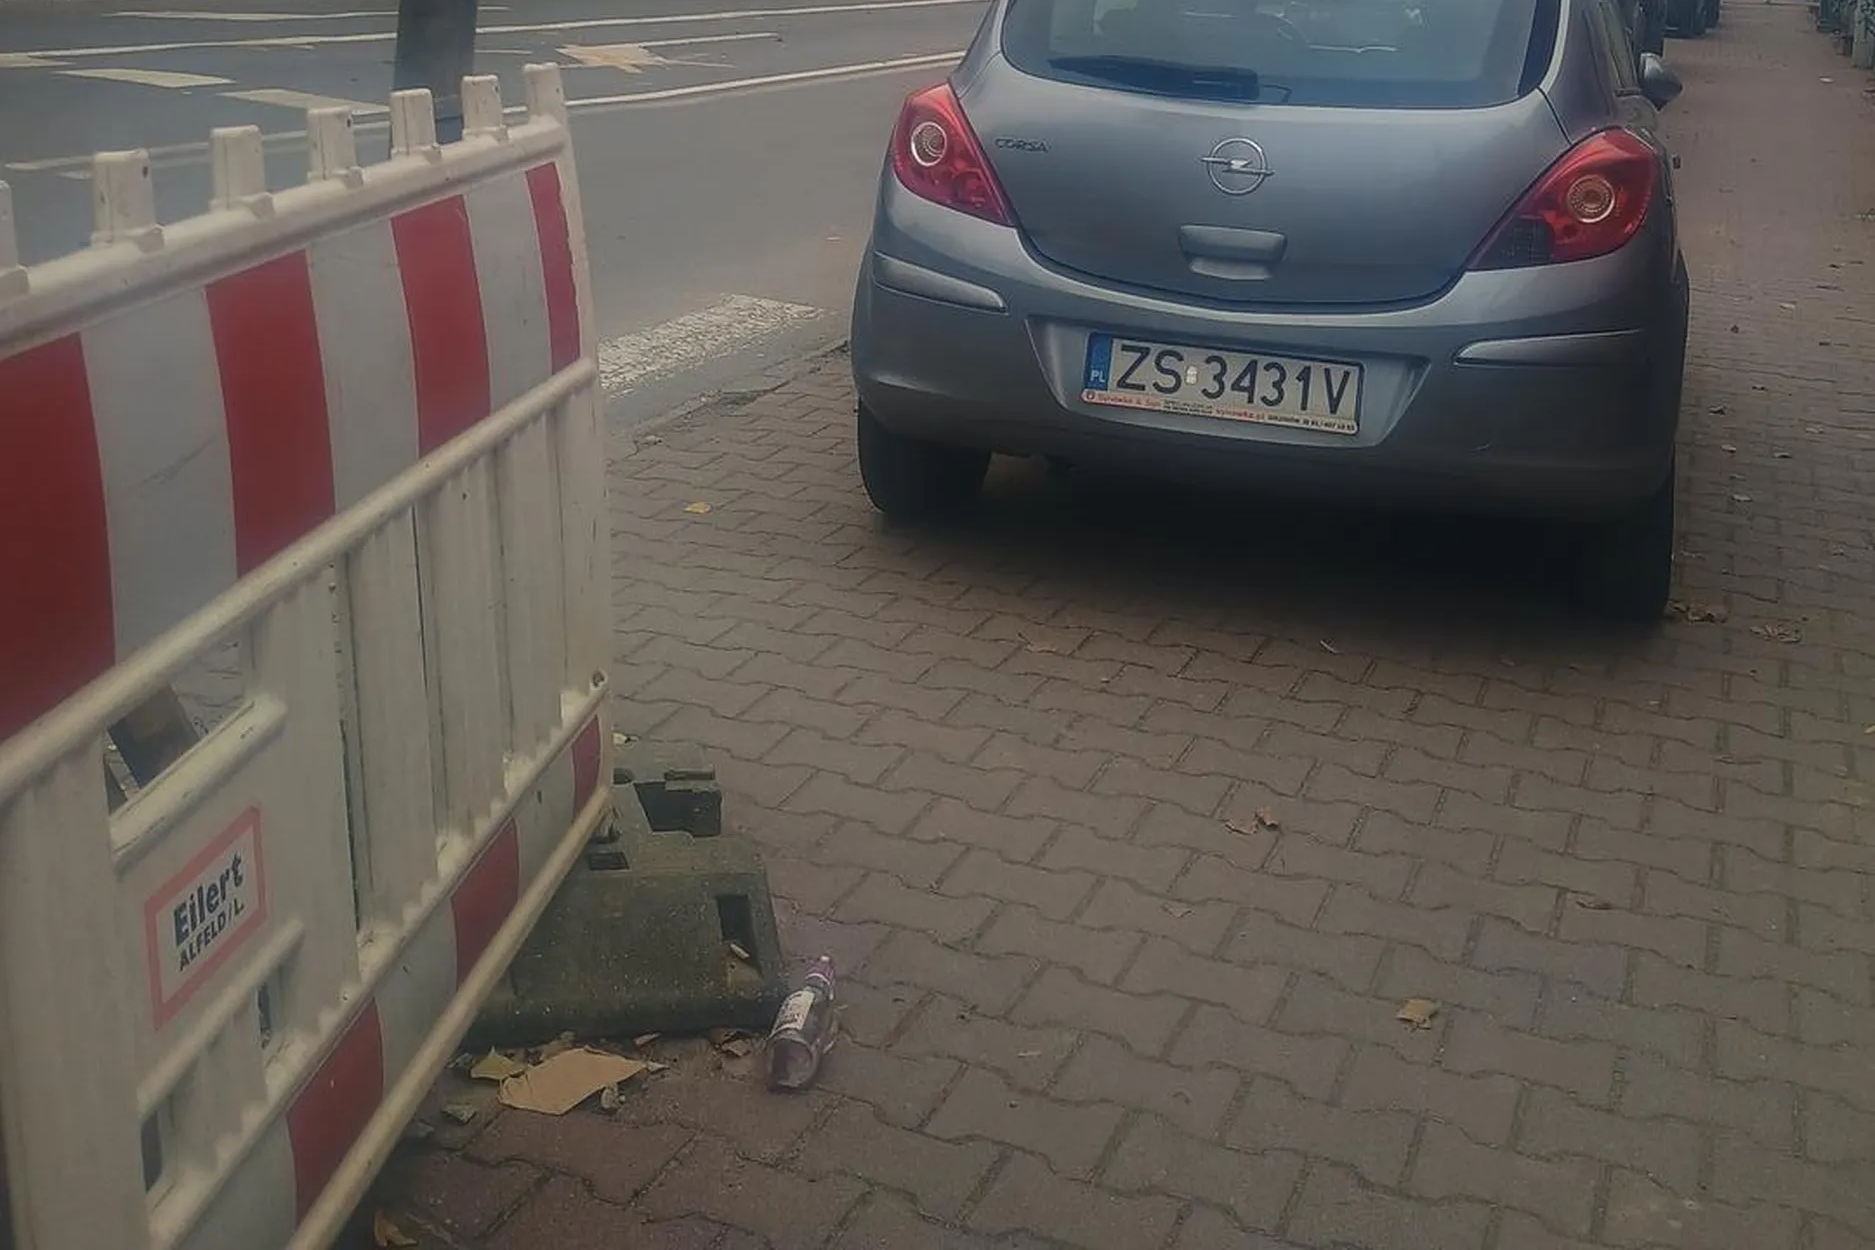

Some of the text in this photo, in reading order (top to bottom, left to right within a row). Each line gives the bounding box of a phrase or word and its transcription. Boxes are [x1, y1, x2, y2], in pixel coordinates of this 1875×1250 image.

[994, 137, 1049, 153] CORSA
[1091, 369, 1106, 383] PL
[1116, 344, 1350, 415] ZS 3431V
[173, 853, 243, 947] Eilert
